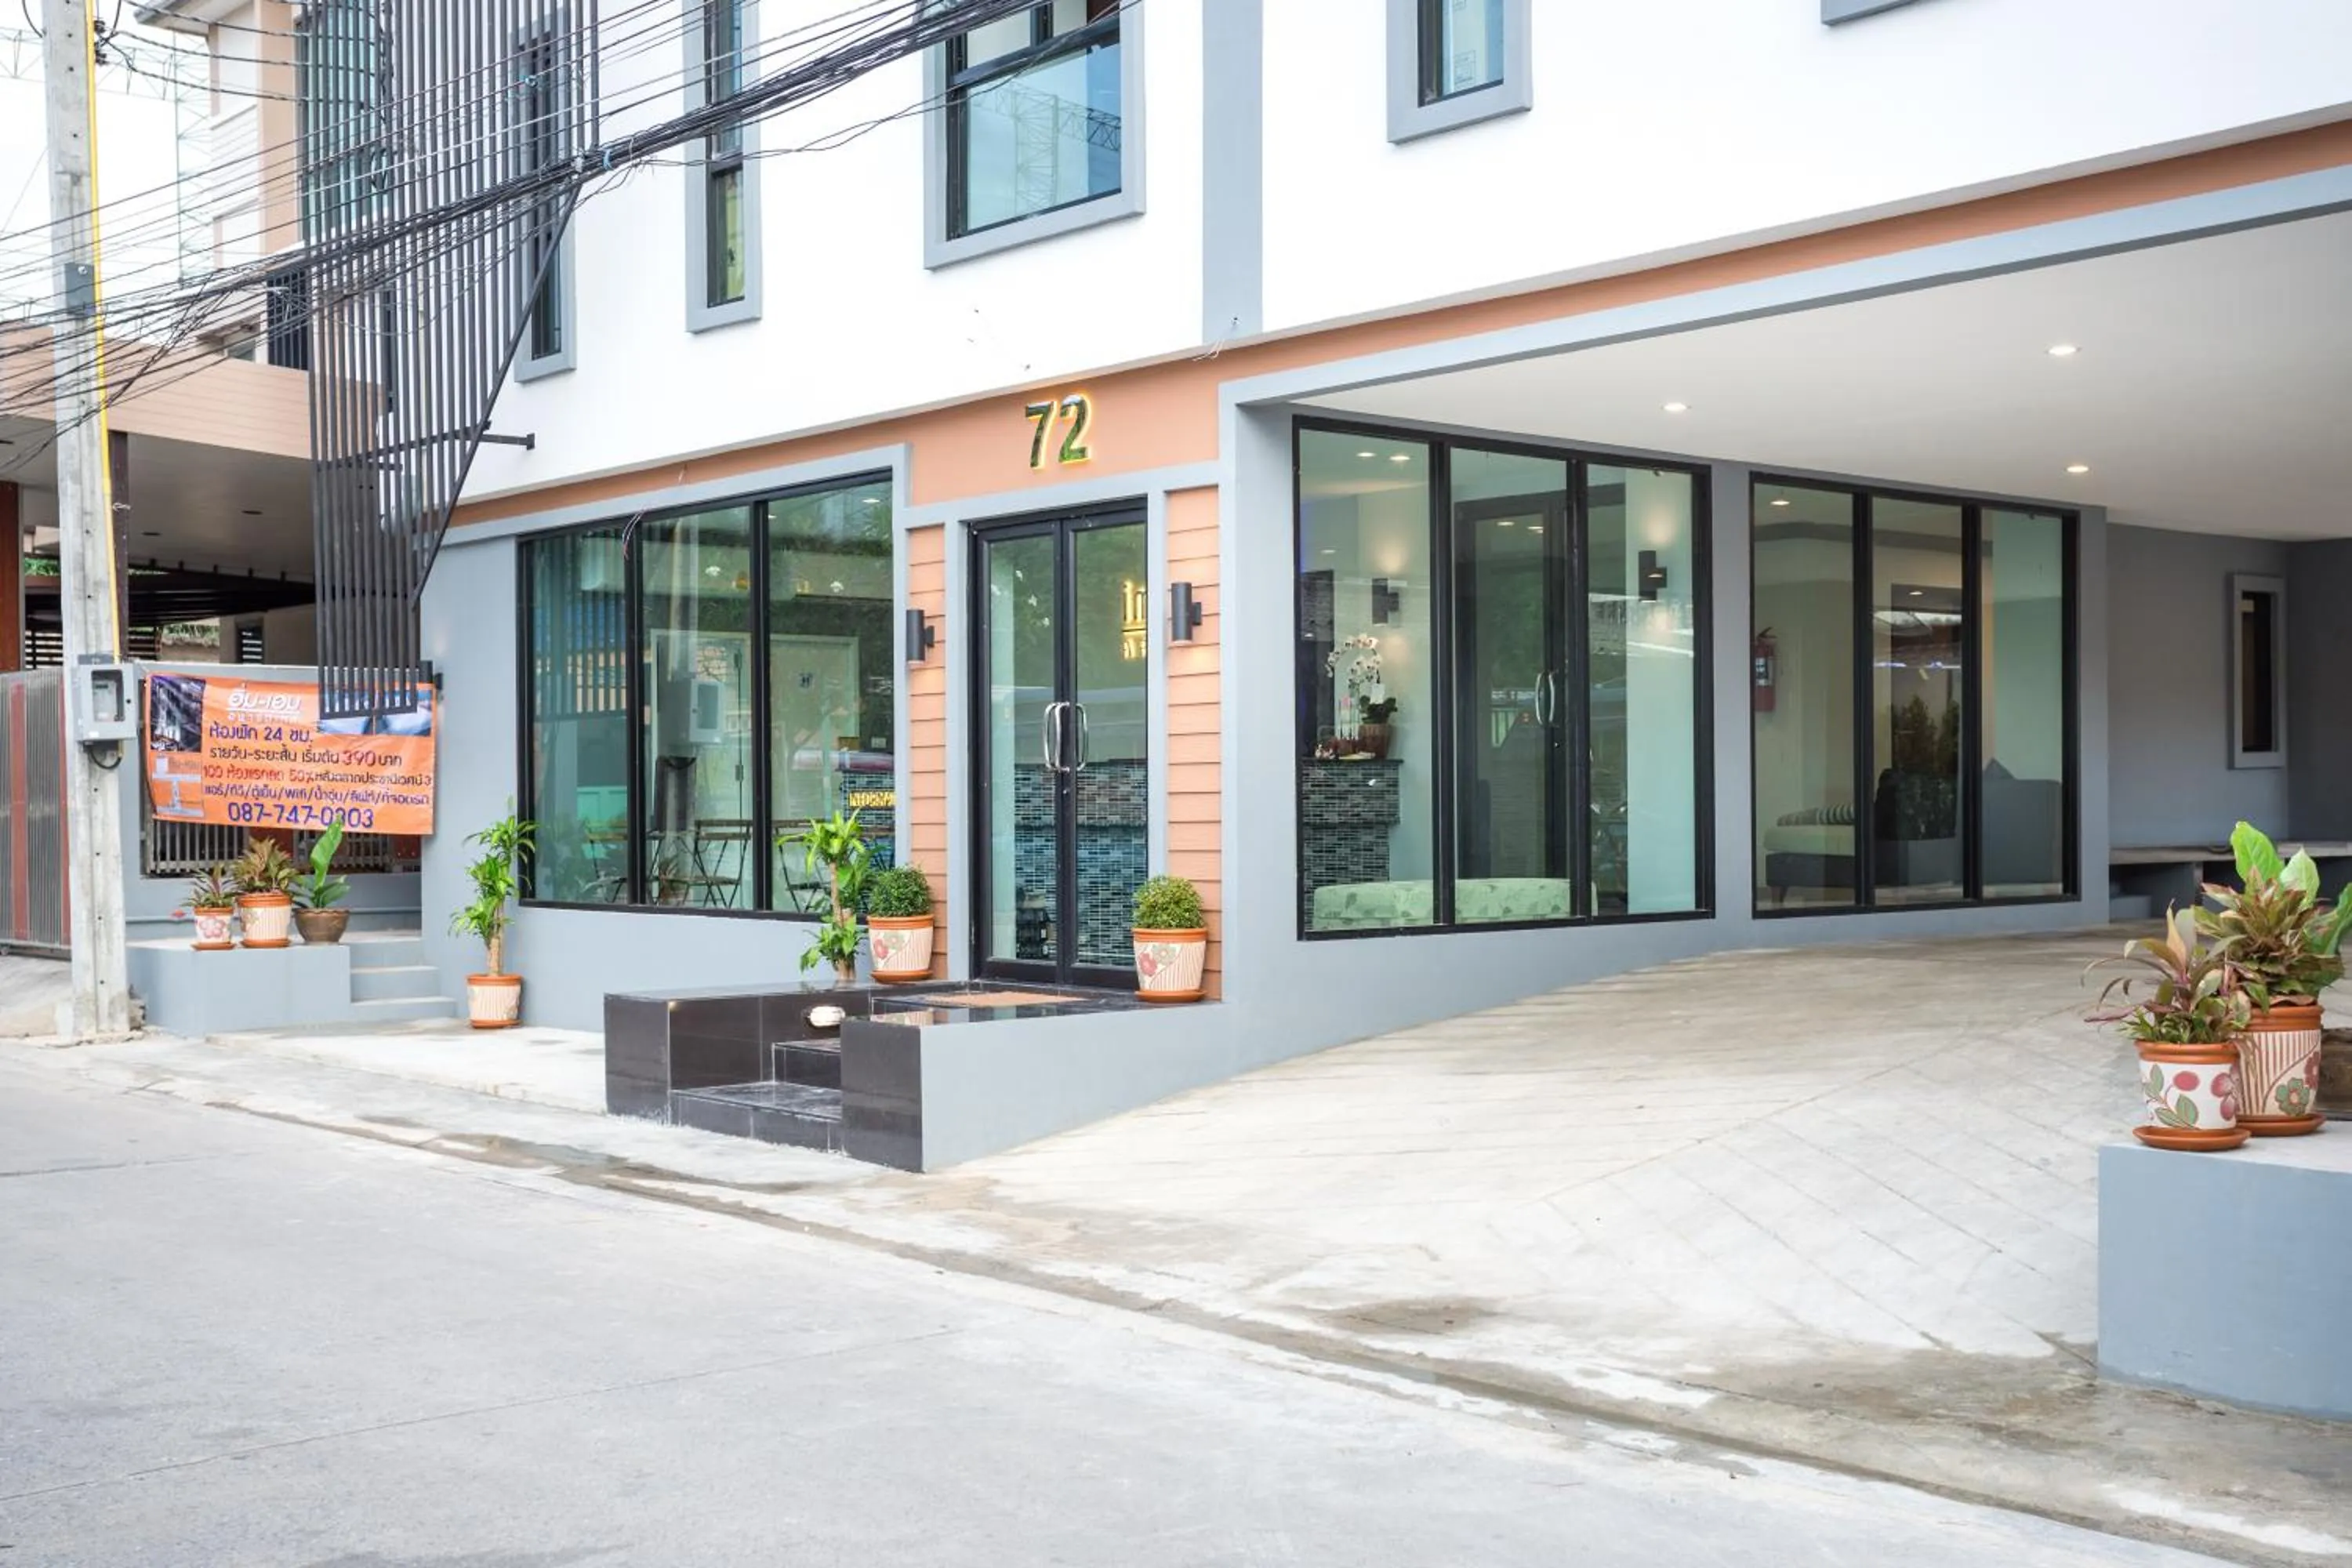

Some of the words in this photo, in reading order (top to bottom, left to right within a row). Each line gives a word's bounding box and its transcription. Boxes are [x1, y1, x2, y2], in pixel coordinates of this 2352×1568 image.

[1025, 394, 1091, 469] 72
[209, 721, 257, 739] ห้องพัก
[264, 727, 282, 741] 24
[343, 750, 376, 767] 390
[378, 754, 401, 767] บาท
[203, 765, 223, 779] 100
[289, 769, 314, 783] 50%
